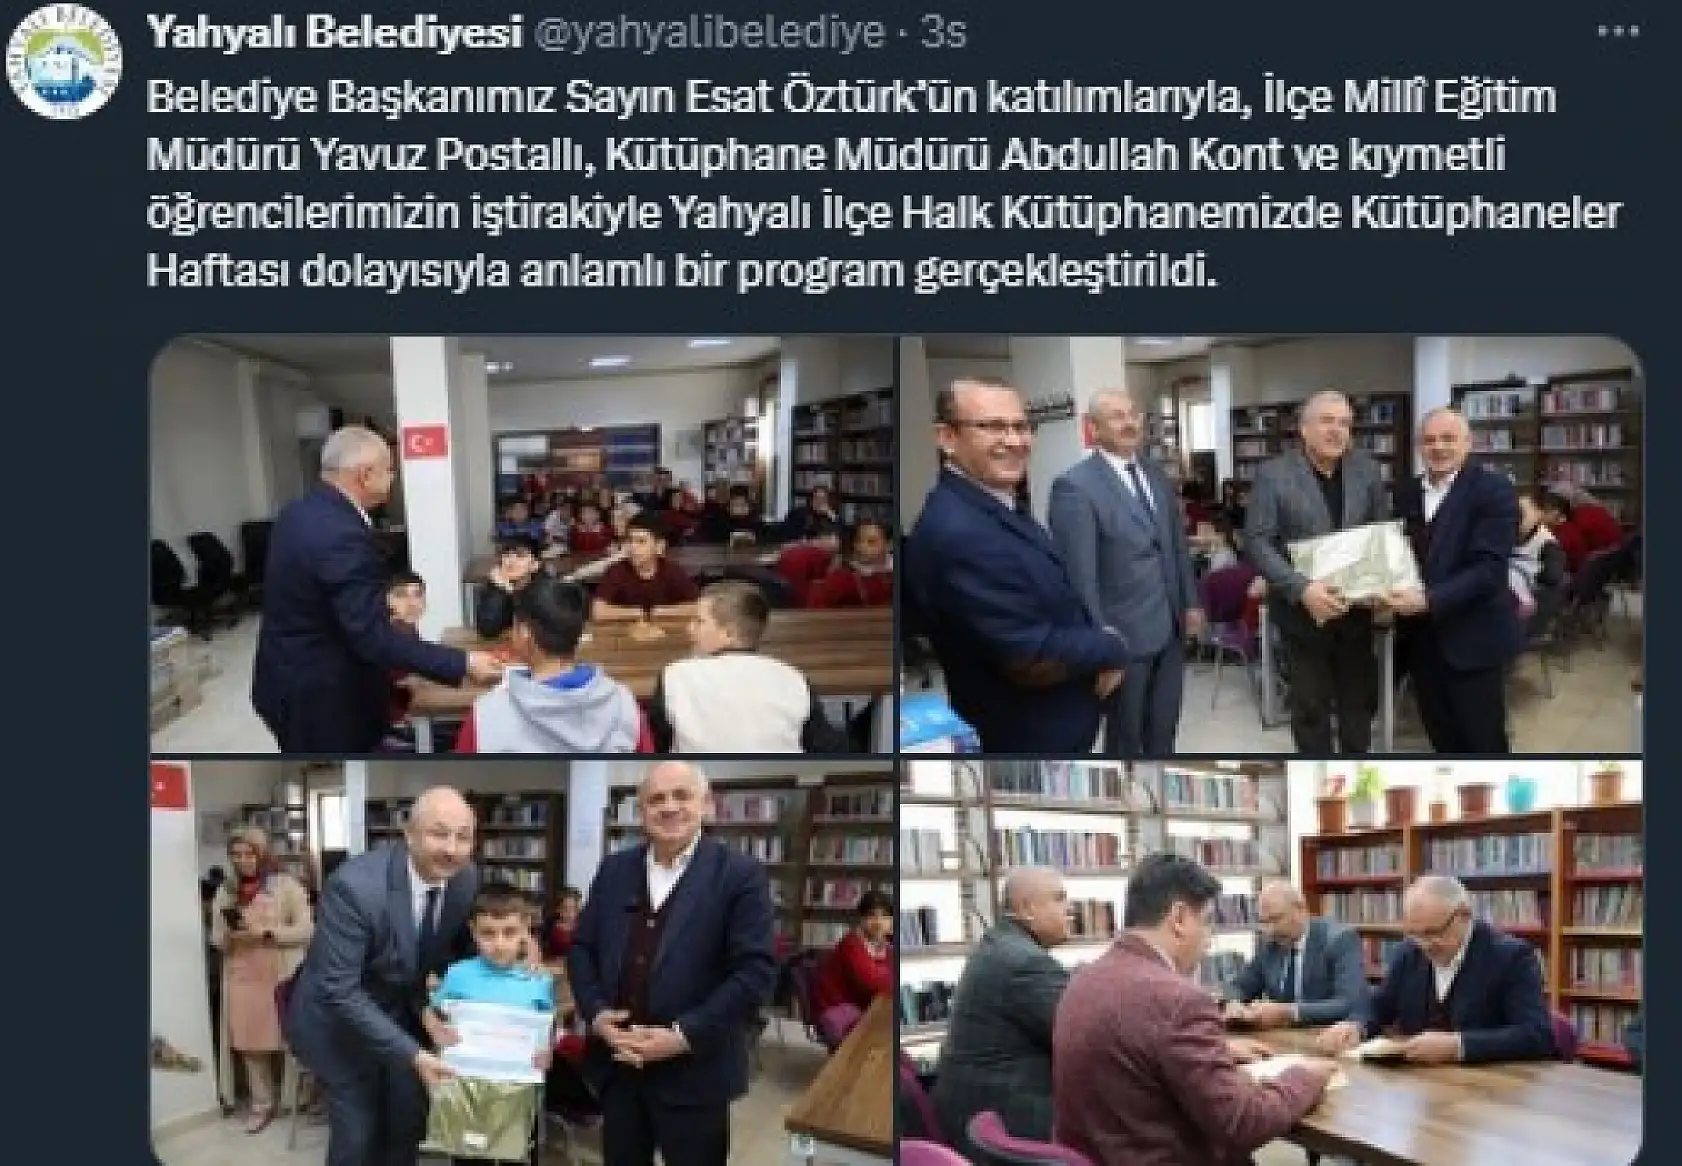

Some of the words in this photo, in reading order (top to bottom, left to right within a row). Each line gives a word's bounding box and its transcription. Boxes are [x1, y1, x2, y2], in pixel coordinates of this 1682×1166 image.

[147, 13, 296, 55] Yahyalı
[306, 13, 524, 55] Belediyesi
[535, 13, 886, 55] @yahyalibelediye
[922, 14, 966, 48] 3s
[147, 78, 319, 121] Belediye
[328, 80, 557, 121] Başkanımız
[564, 80, 676, 121] Sayın
[686, 80, 774, 112] Esat
[987, 80, 1252, 121] katılımlarıyla,
[1262, 71, 1335, 121] İlçe
[1435, 75, 1556, 121] Eğitim
[147, 137, 300, 170] Müdürü
[310, 137, 429, 172] Yavuz
[436, 137, 597, 179] Postallı,
[606, 137, 828, 179] Kütüphane
[835, 137, 990, 170] Müdürü
[997, 137, 1179, 170] Abdullah
[1189, 137, 1284, 170] Kont
[1291, 144, 1339, 170] ve
[1349, 134, 1505, 179] kıymetli
[147, 192, 460, 236] öğrencilerimizin
[470, 192, 662, 236] iştirakiyle
[669, 195, 810, 236] Yahyalı
[821, 188, 893, 236] İlçe
[903, 195, 995, 228] Halk
[1002, 192, 1342, 236] Kütüphanemizde
[1352, 195, 1624, 236] Kütüphaneler
[147, 253, 290, 287] Haftası
[300, 253, 509, 294] dolayısıyla
[519, 253, 665, 287] anlamlı
[675, 250, 730, 287] bir
[737, 256, 905, 294] program
[914, 250, 1218, 294] gerçekleştirildi.
